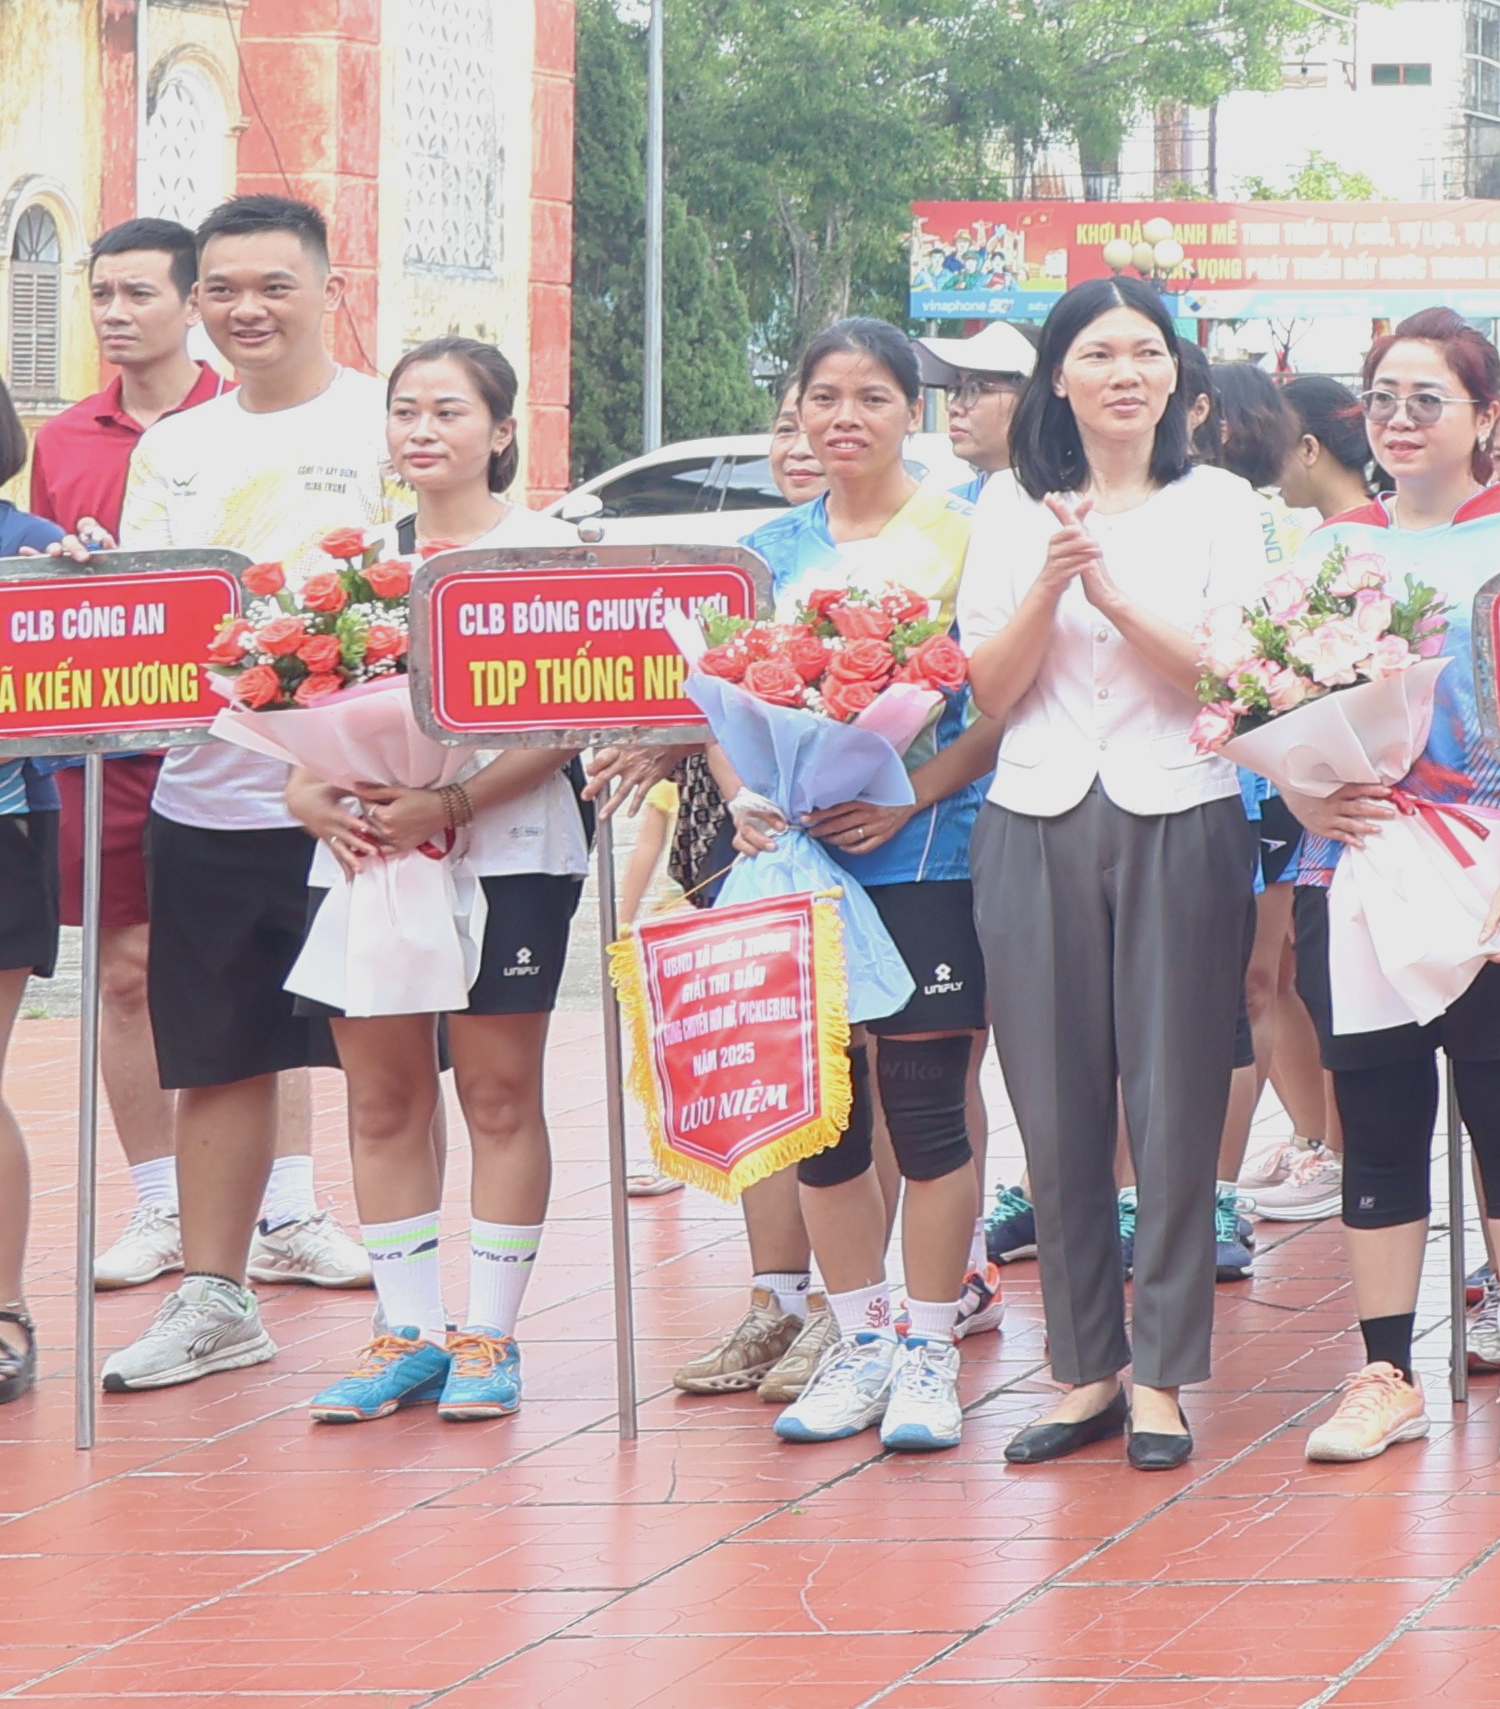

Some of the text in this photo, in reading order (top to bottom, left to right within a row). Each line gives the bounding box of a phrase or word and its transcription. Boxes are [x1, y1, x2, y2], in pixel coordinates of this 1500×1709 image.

[923, 299, 985, 313] vinaphone
[11, 601, 165, 642] CLB CÔNG AN
[459, 595, 579, 636] CLB BÓNG
[26, 657, 198, 711] KIẾN XƯƠNG
[469, 641, 633, 706] TDP THỐNG
[503, 965, 540, 977] UNIFLY
[663, 951, 692, 978] UBND
[682, 974, 705, 1004] GIẢI
[709, 973, 730, 996] THI
[924, 982, 963, 995] UNIFLY
[739, 996, 798, 1025] PICKLEBALL
[720, 1042, 756, 1069] 2025
[681, 1079, 788, 1133] LƯU NIỆM
